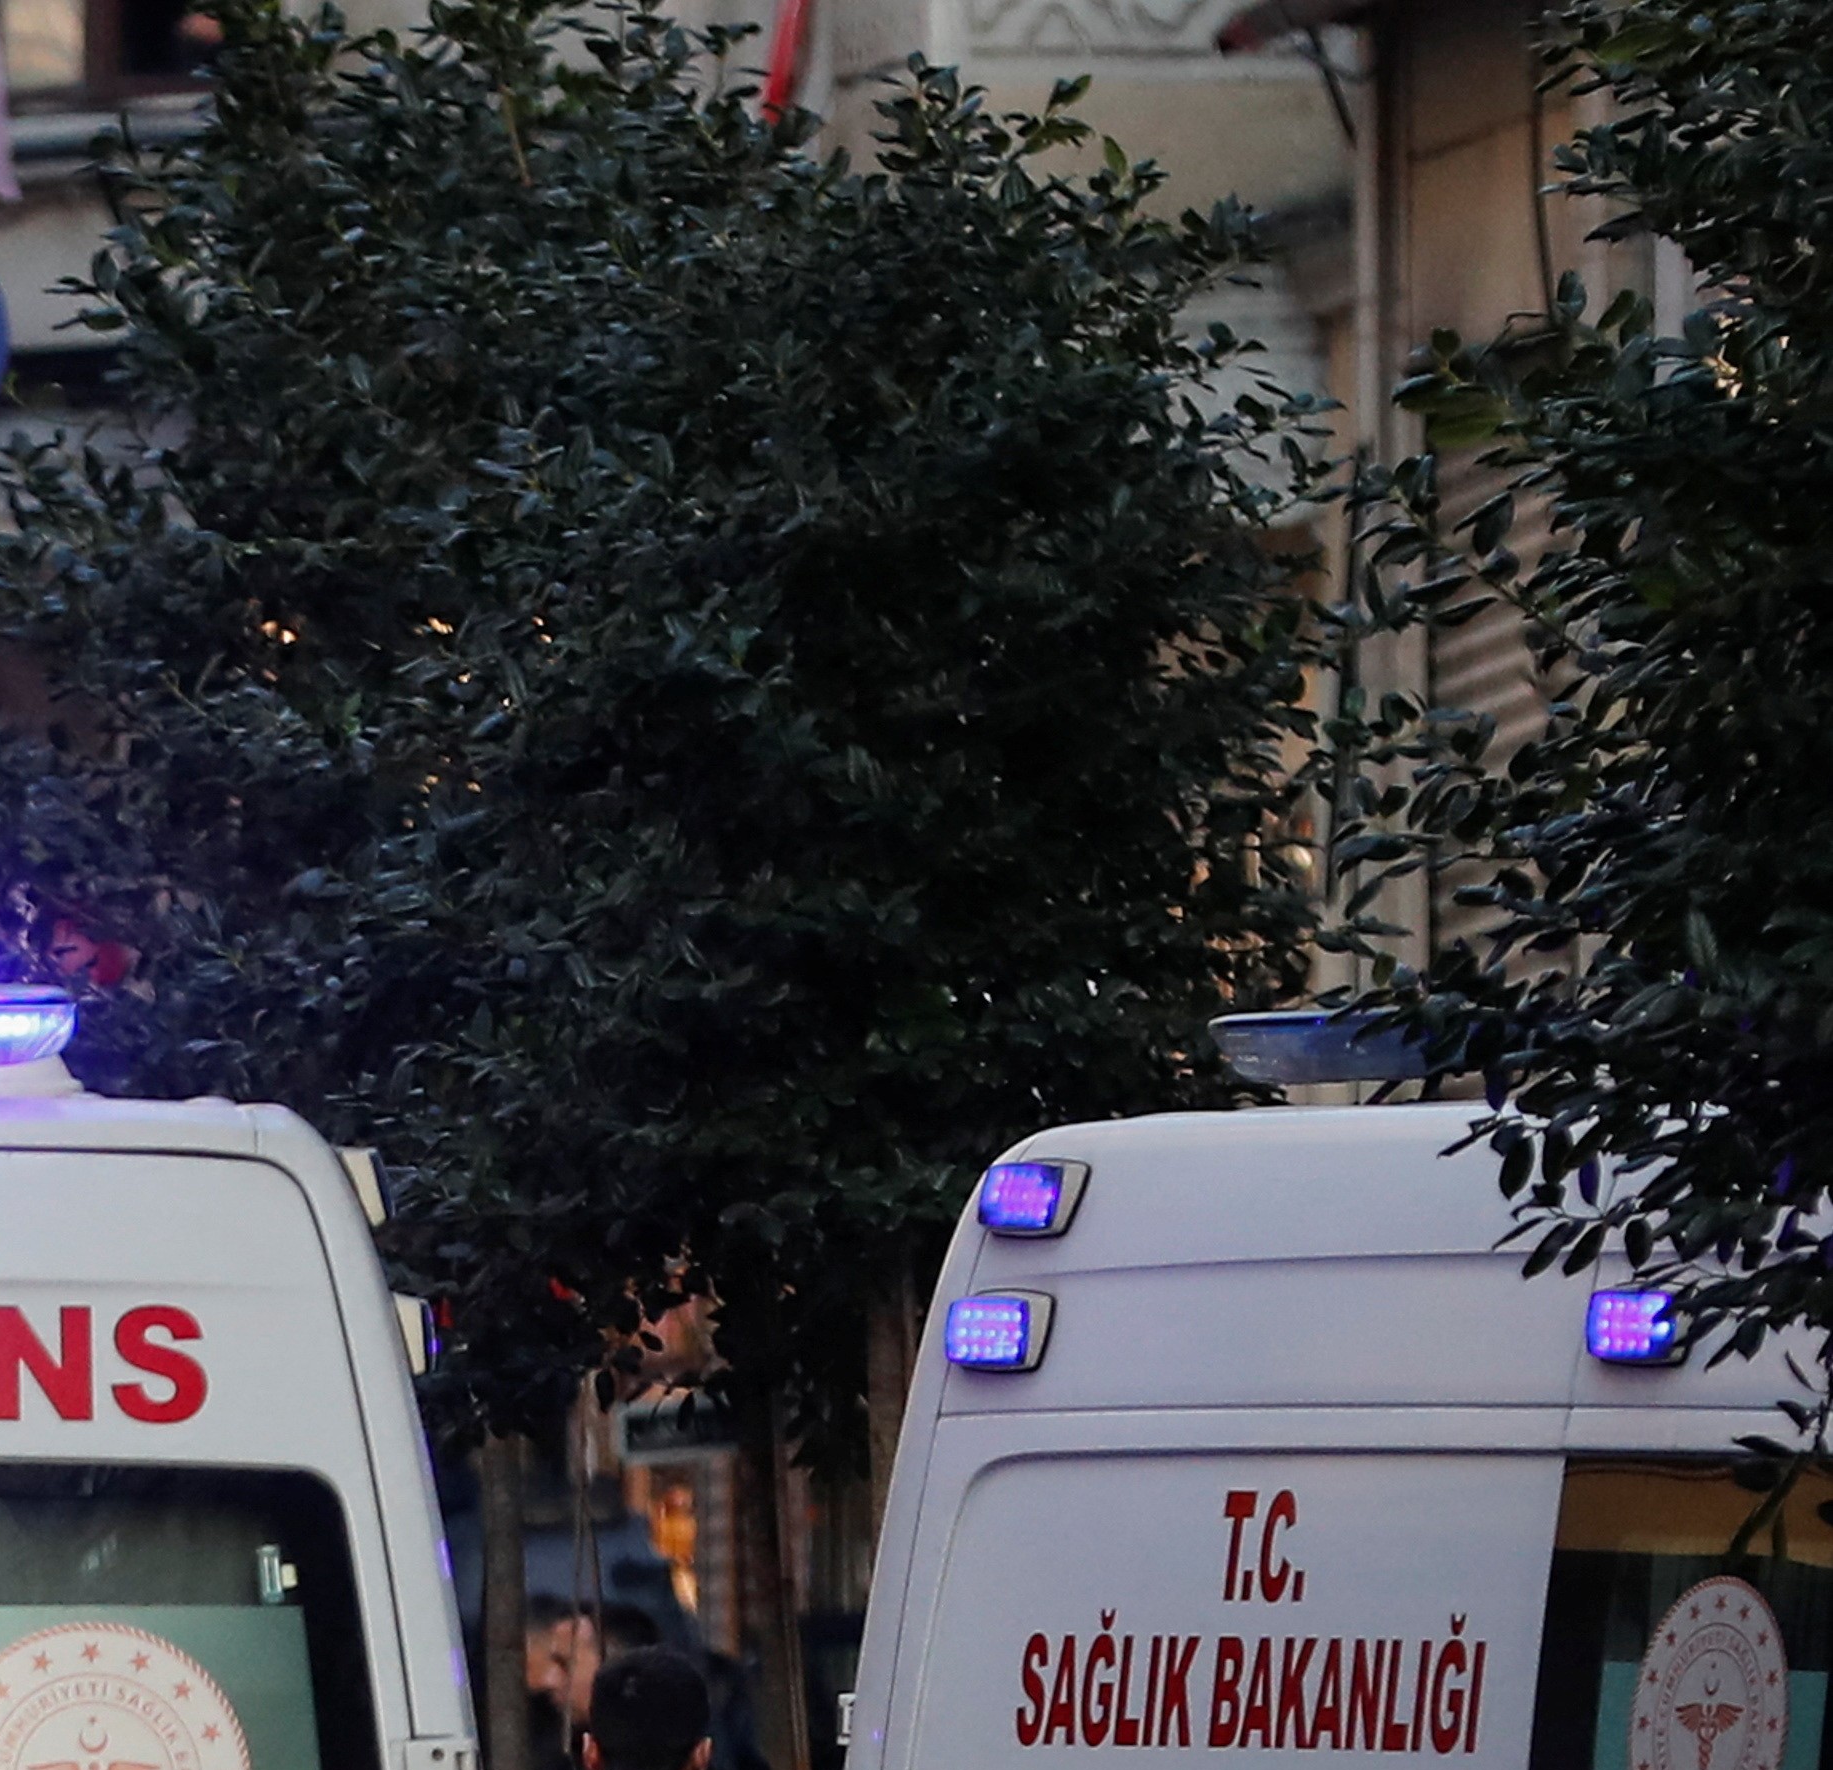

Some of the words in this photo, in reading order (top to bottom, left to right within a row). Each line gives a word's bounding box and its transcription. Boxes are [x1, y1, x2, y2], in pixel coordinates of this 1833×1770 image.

[1223, 1489, 1308, 1602] T.C.
[1015, 1608, 1202, 1748] SAĞLIK
[1208, 1613, 1488, 1754] BAKANLIĞI
